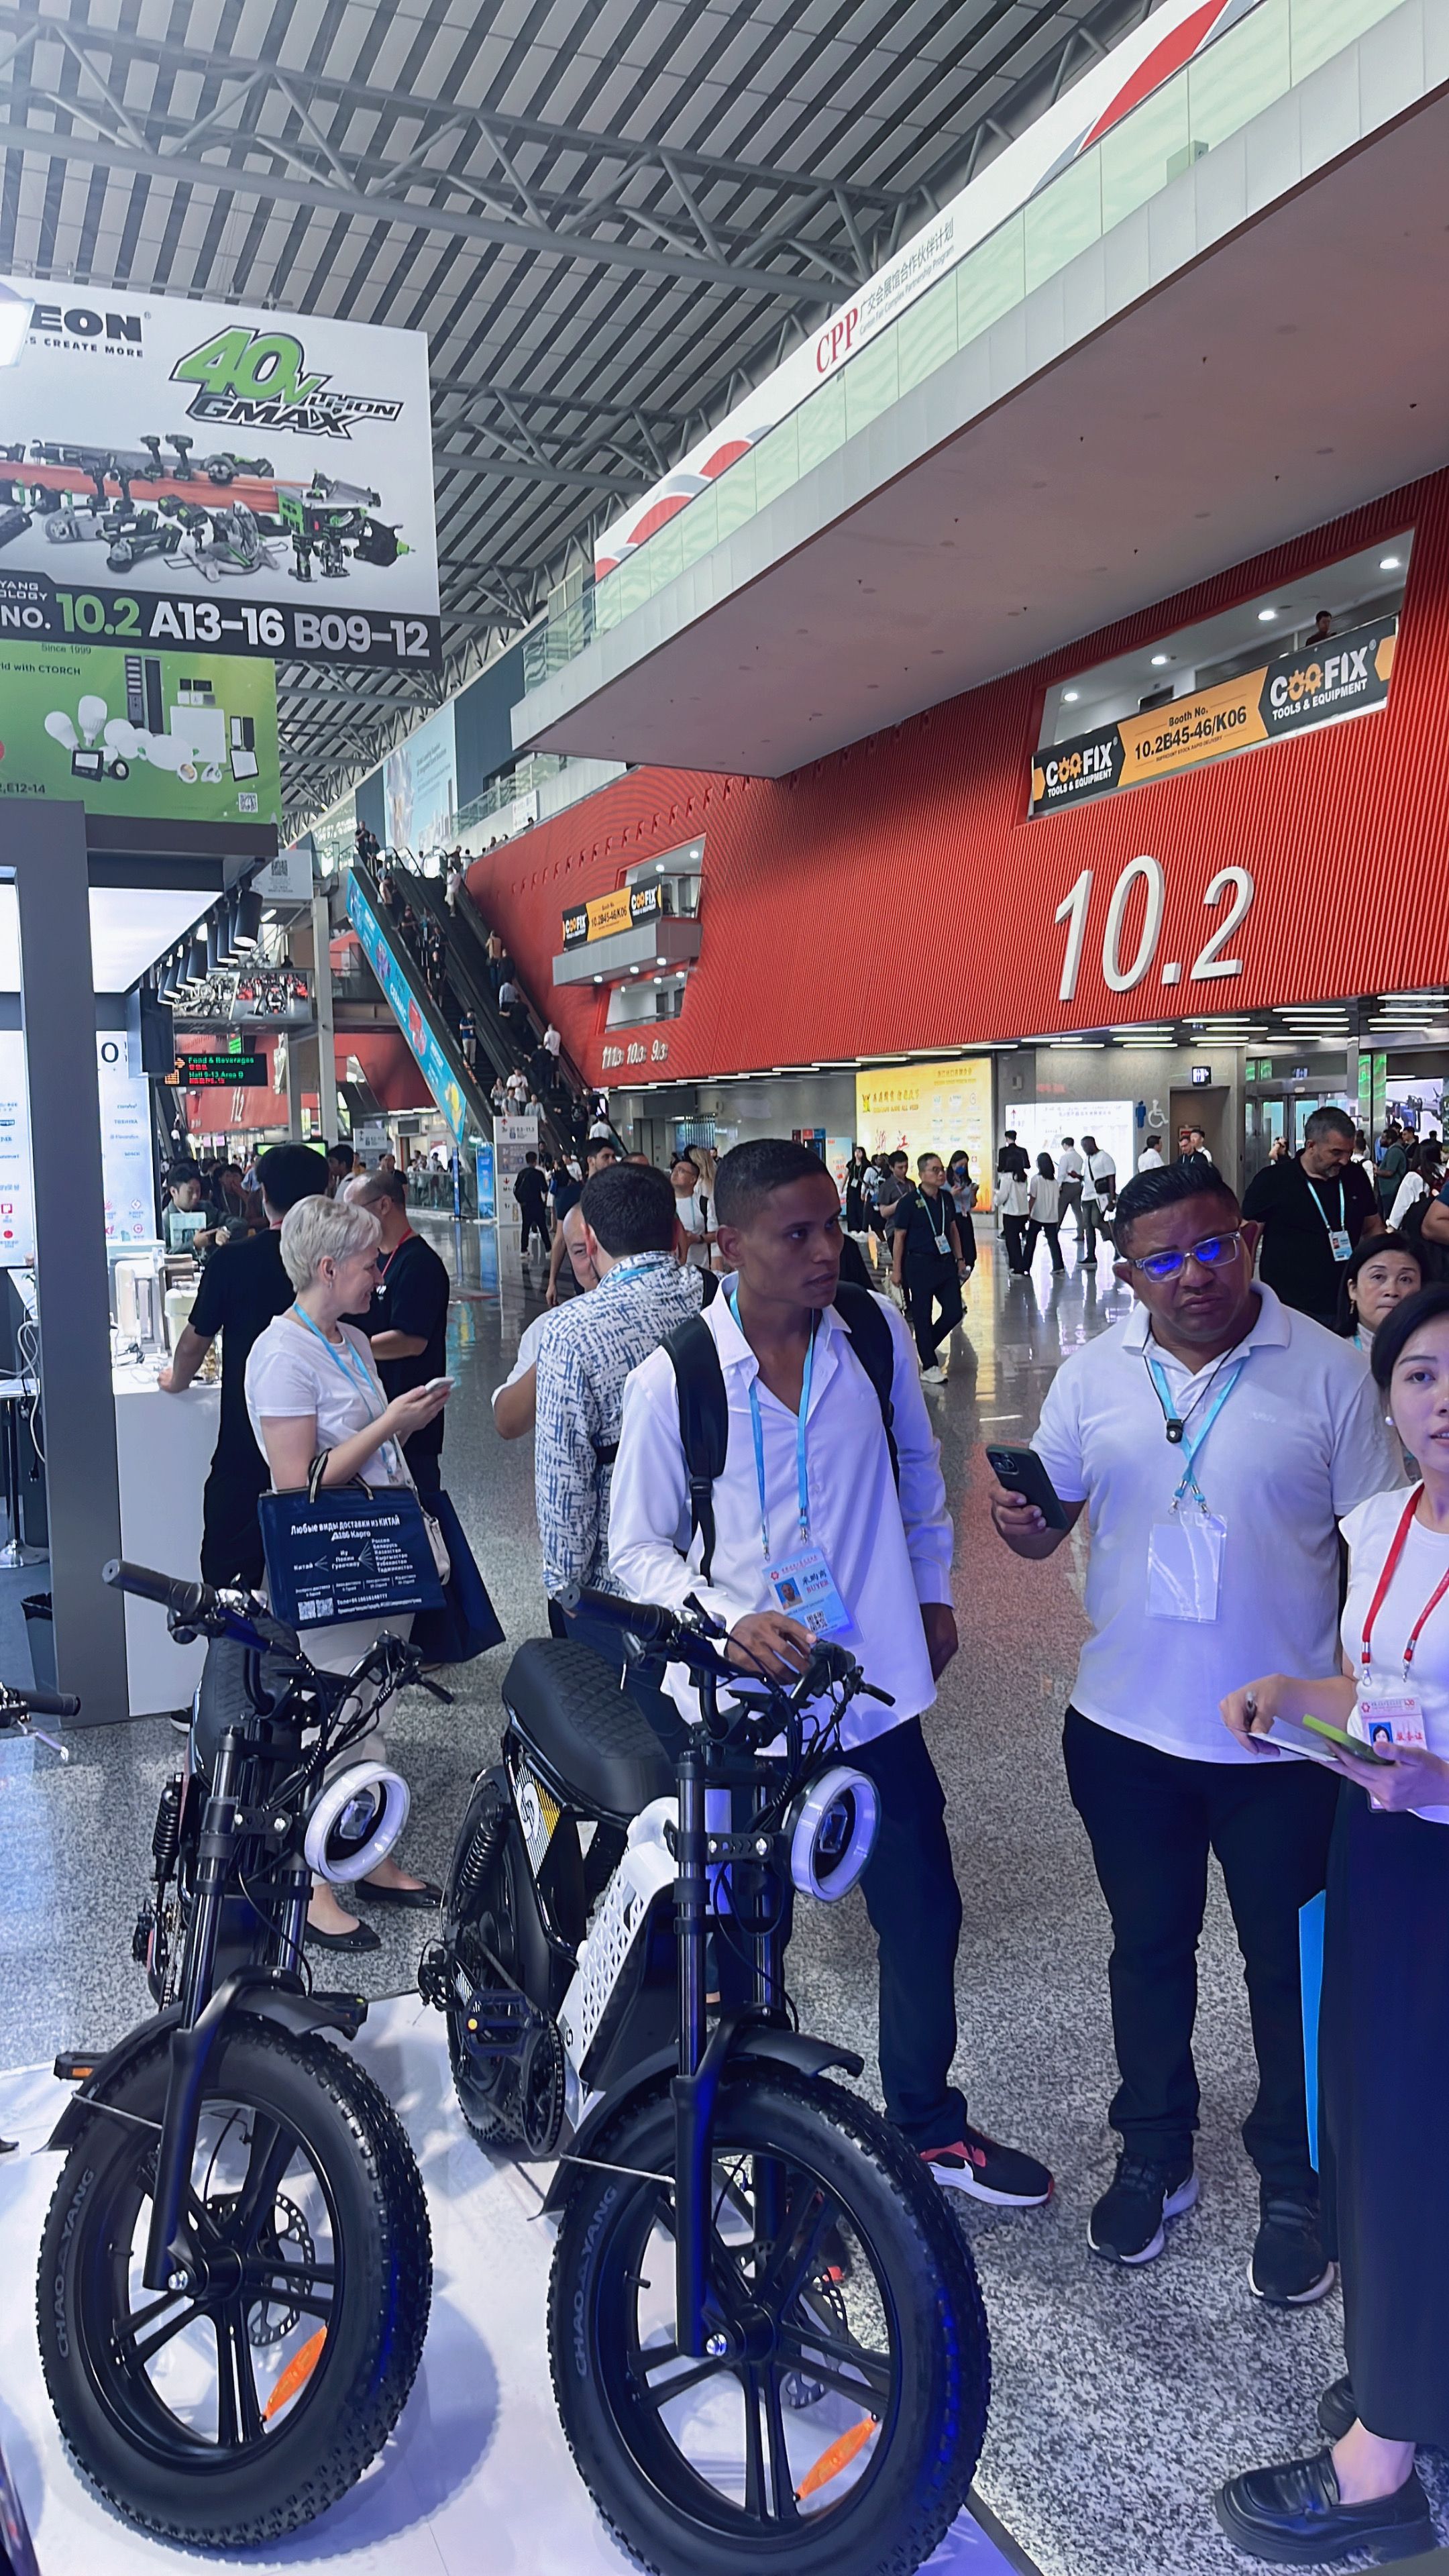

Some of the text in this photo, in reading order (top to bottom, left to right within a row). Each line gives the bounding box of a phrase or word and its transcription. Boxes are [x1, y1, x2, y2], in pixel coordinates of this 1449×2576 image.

[933, 245, 954, 268] Program
[860, 217, 954, 322] 广交会展馆合作伙伴计划
[44, 337, 97, 352] CREATE
[105, 345, 144, 358] MORE
[816, 307, 858, 374] CPP
[195, 396, 353, 436] GMAX
[1, 593, 429, 657] NO. 10.2 A13-16 B09-12
[42, 643, 91, 655] Since 1999
[13, 663, 35, 672] with
[38, 665, 80, 676] CTORCH
[1273, 678, 1367, 720] TOOLS & EQUIPMENT
[1169, 706, 1208, 727] Booth No.
[1135, 706, 1247, 760] 10.2B45-46/K06
[1048, 767, 1113, 798] TOOLS & EQUIPMENT
[1054, 855, 1254, 1001] 10.2
[215, 1057, 254, 1065] Beverages
[651, 1039, 667, 1061] 9.3
[290, 1514, 400, 1536] Любые виды доставки из КИТАЙ
[351, 1530, 371, 1540] Карго
[294, 1563, 313, 1571] Китай
[806, 1580, 830, 1594] BUYER
[54, 2167, 94, 2359] CHAO YANG
[574, 2185, 617, 2377] CHAO YANG
